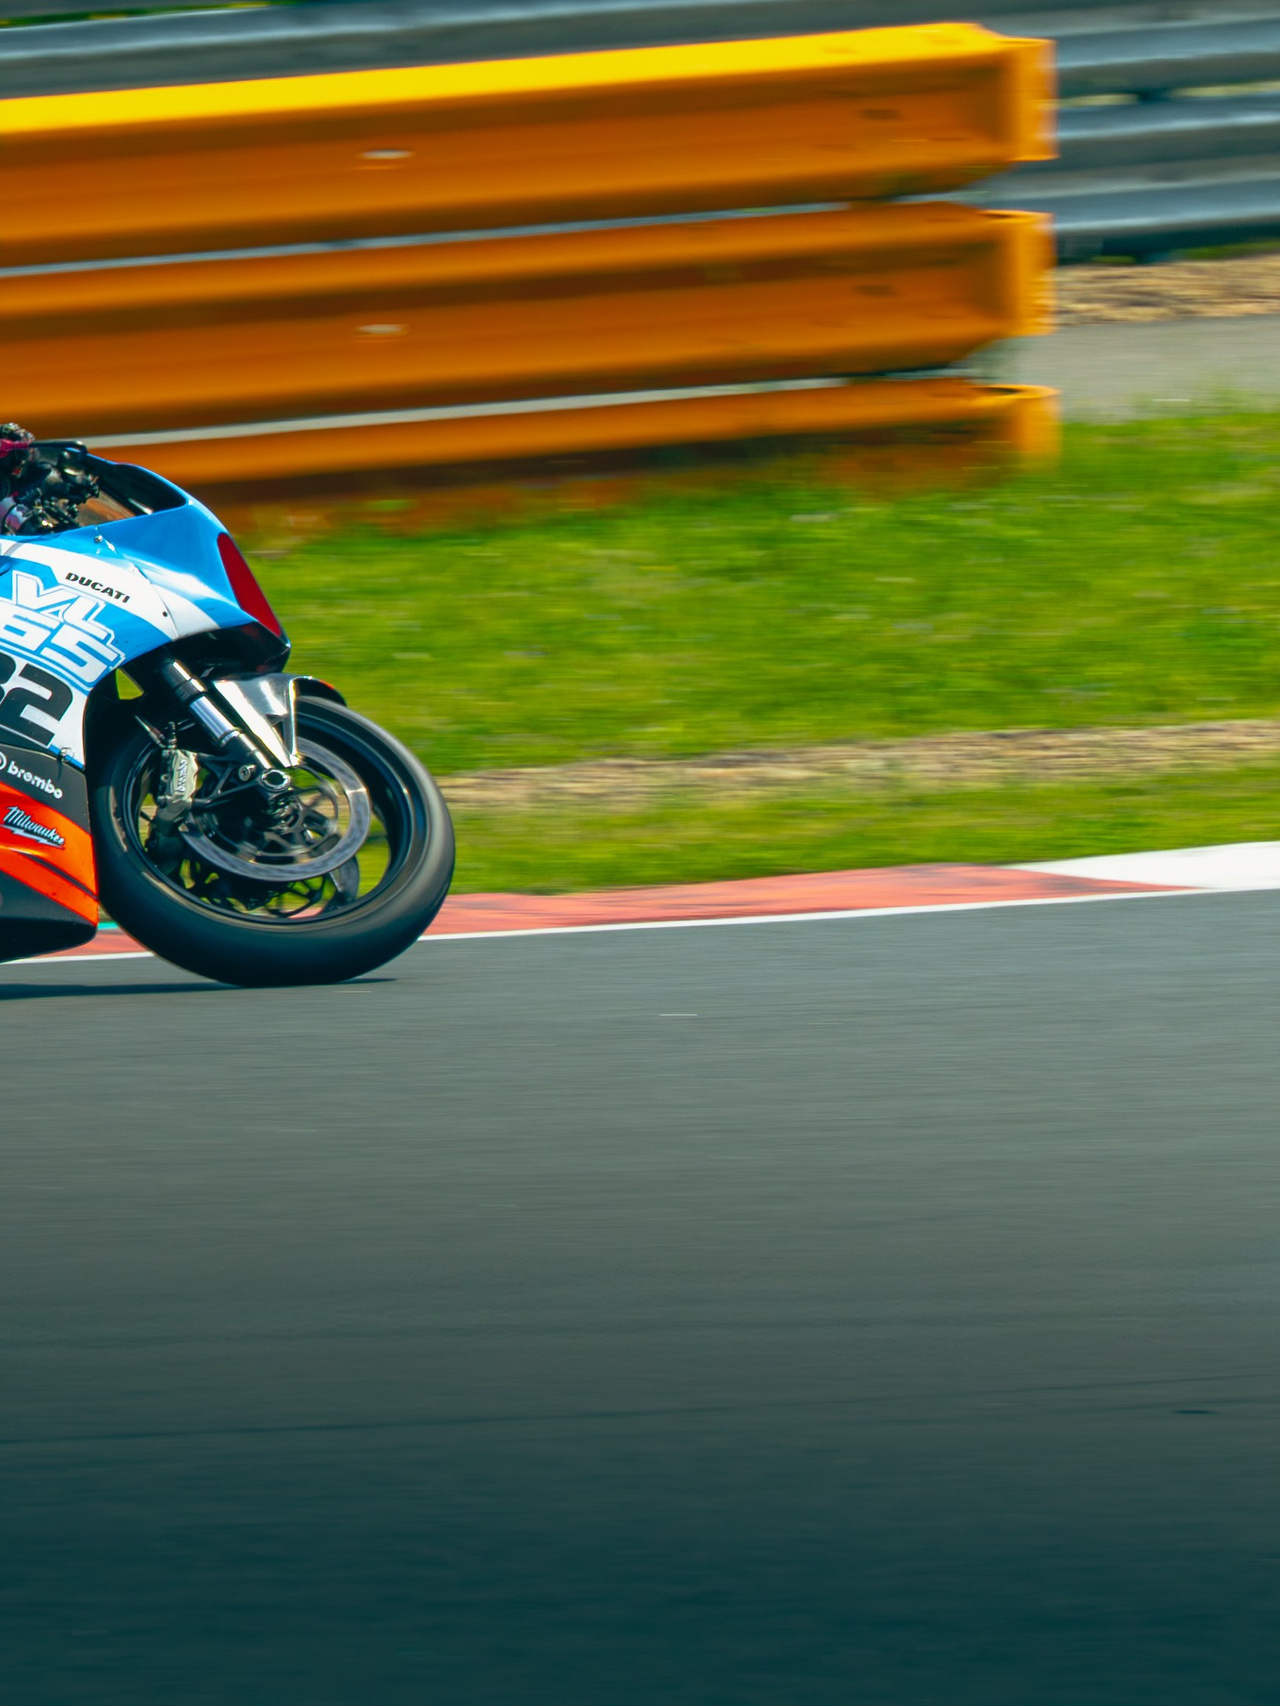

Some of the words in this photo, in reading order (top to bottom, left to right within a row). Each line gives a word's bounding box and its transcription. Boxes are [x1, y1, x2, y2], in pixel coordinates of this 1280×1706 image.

[15, 573, 108, 640] VL
[65, 572, 130, 603] DUCATI
[7, 760, 63, 799] brembo
[3, 806, 65, 845] Milwaukee
